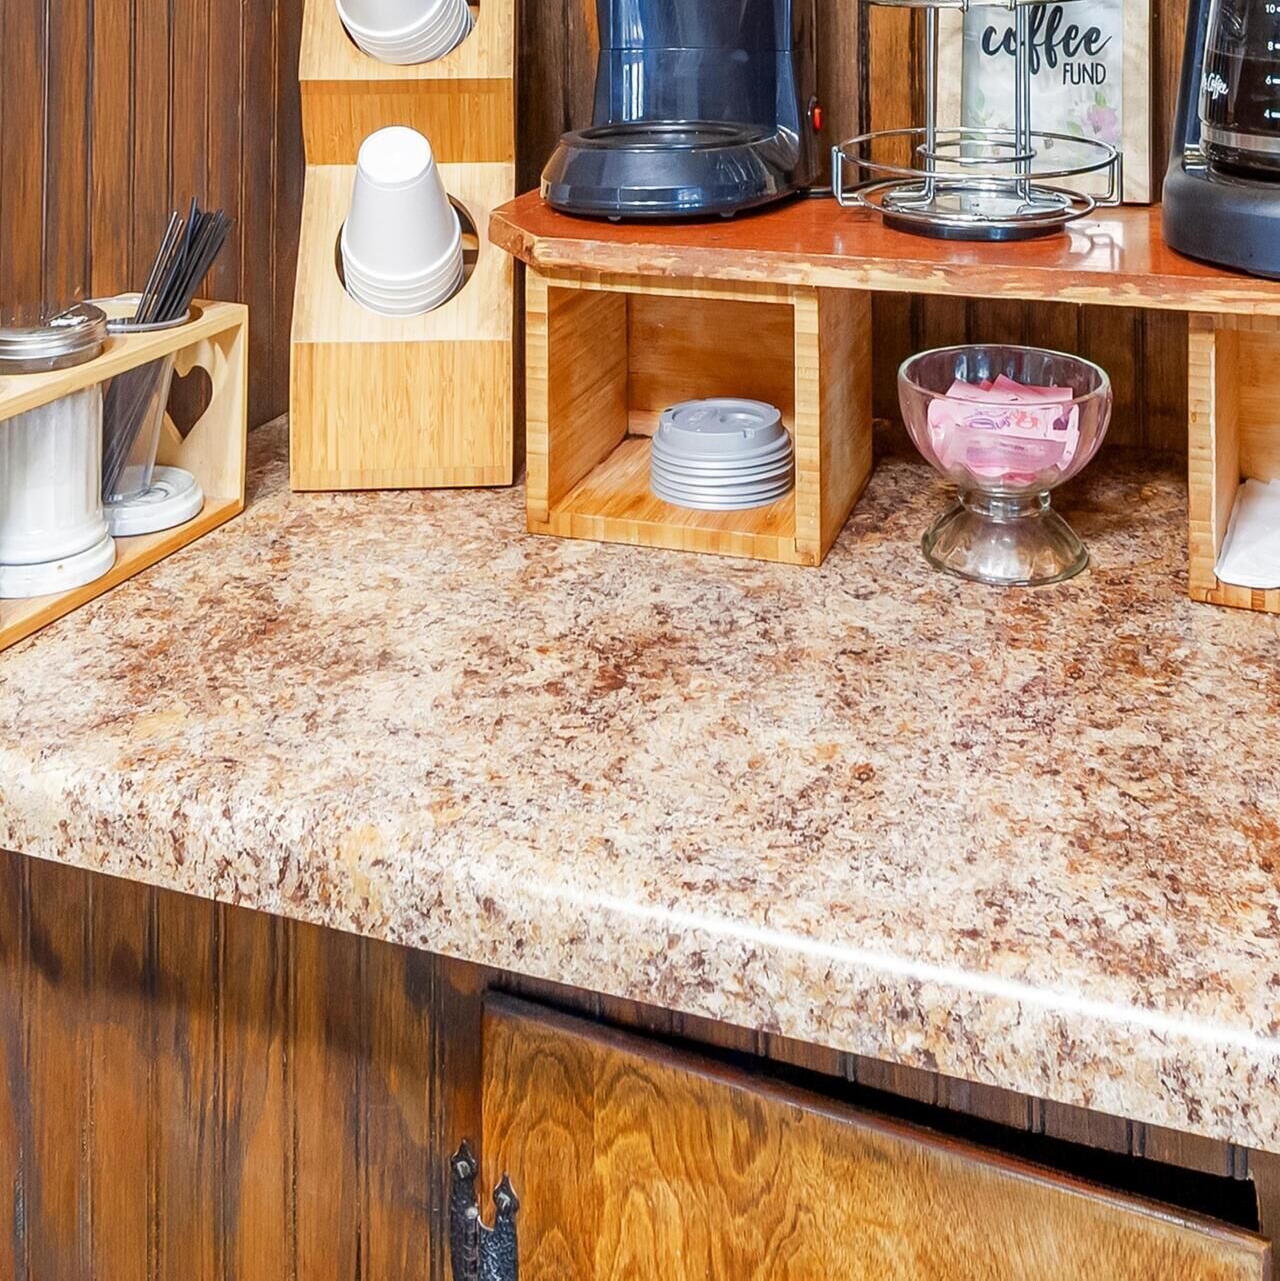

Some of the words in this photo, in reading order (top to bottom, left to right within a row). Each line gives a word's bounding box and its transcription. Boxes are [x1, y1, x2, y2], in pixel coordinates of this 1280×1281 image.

[1265, 4, 1276, 14] 10
[982, 2, 1113, 76] coffee
[1267, 41, 1274, 51] 8
[1062, 62, 1107, 86] FUND
[1265, 76, 1272, 85] 6
[1263, 109, 1270, 119] 4
